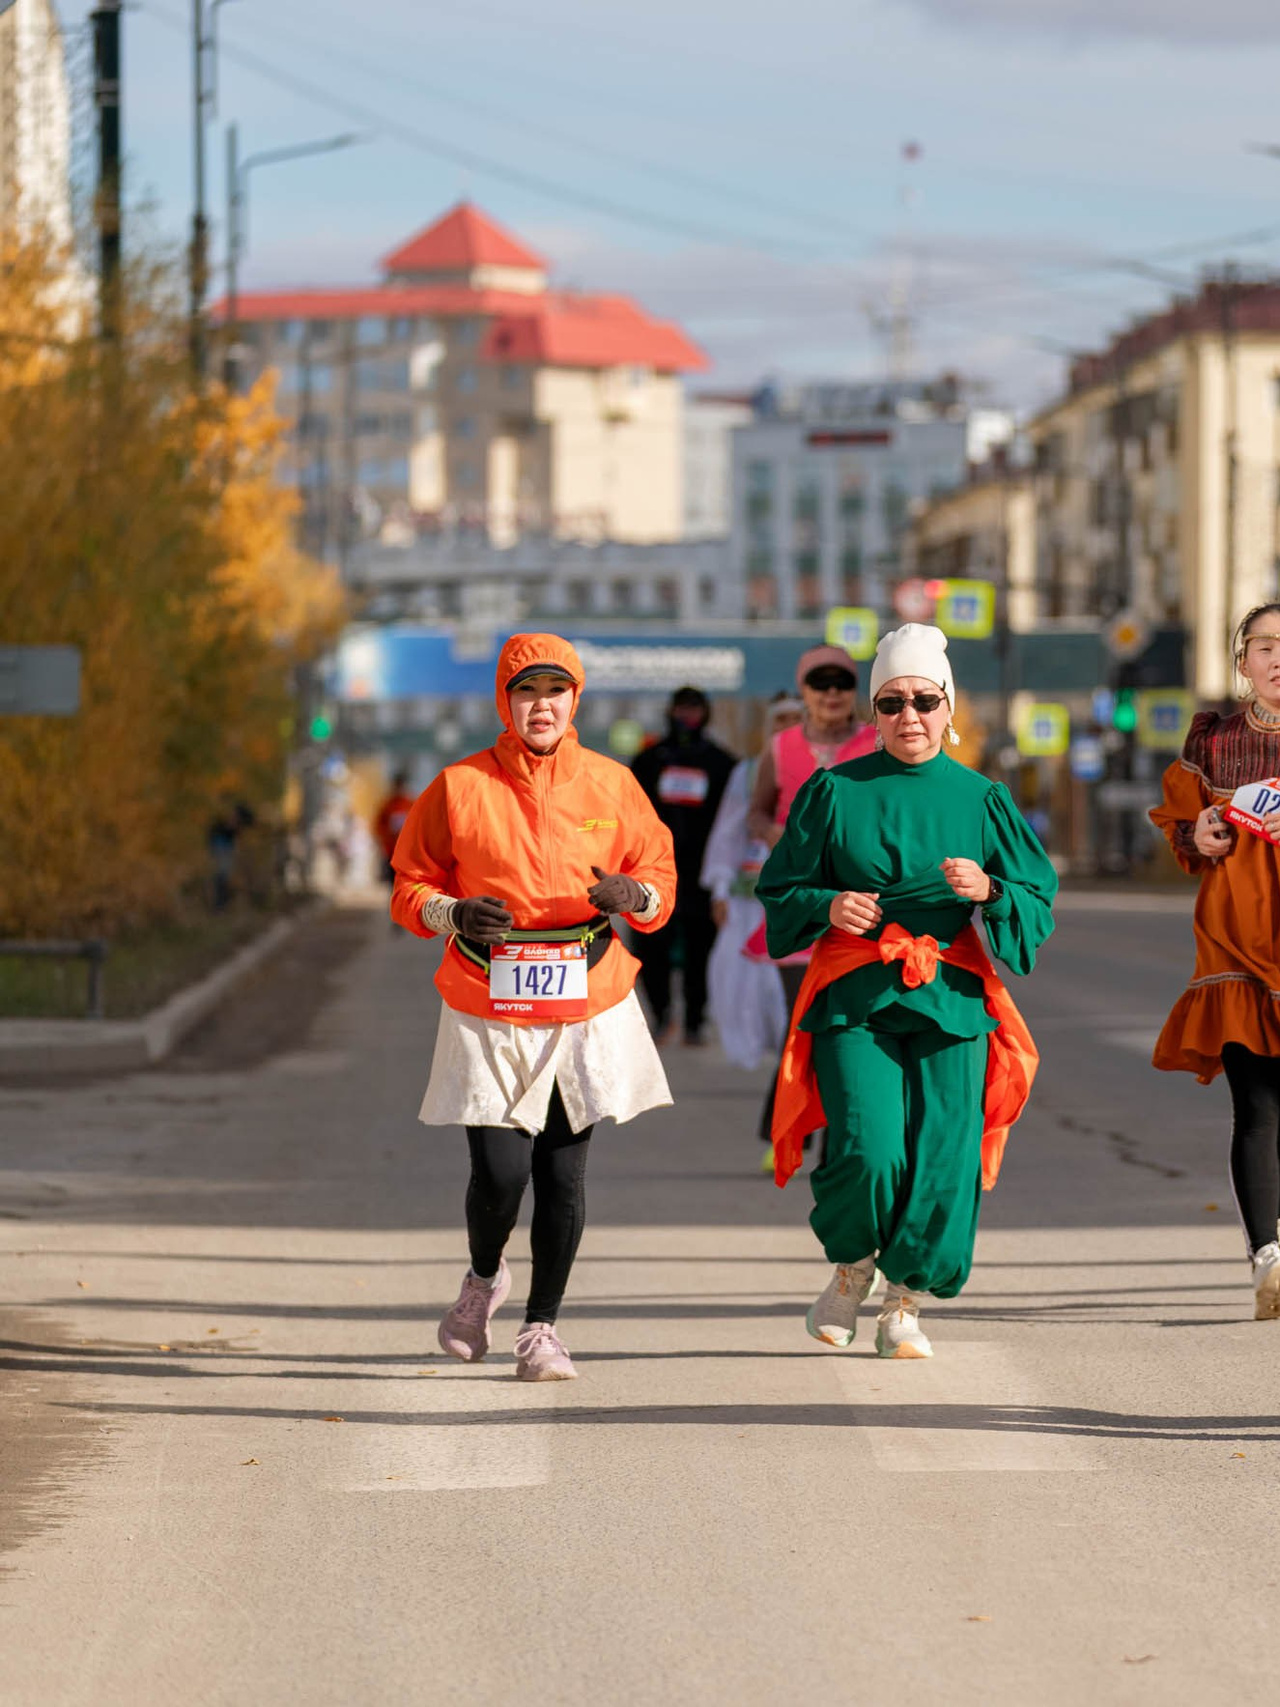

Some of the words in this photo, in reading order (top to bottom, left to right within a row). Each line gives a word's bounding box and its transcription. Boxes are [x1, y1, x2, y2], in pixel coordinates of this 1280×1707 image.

[1229, 810, 1264, 832] ЯКУТСК
[512, 965, 567, 995] 1427
[493, 1002, 533, 1012] ЯКУТСК
